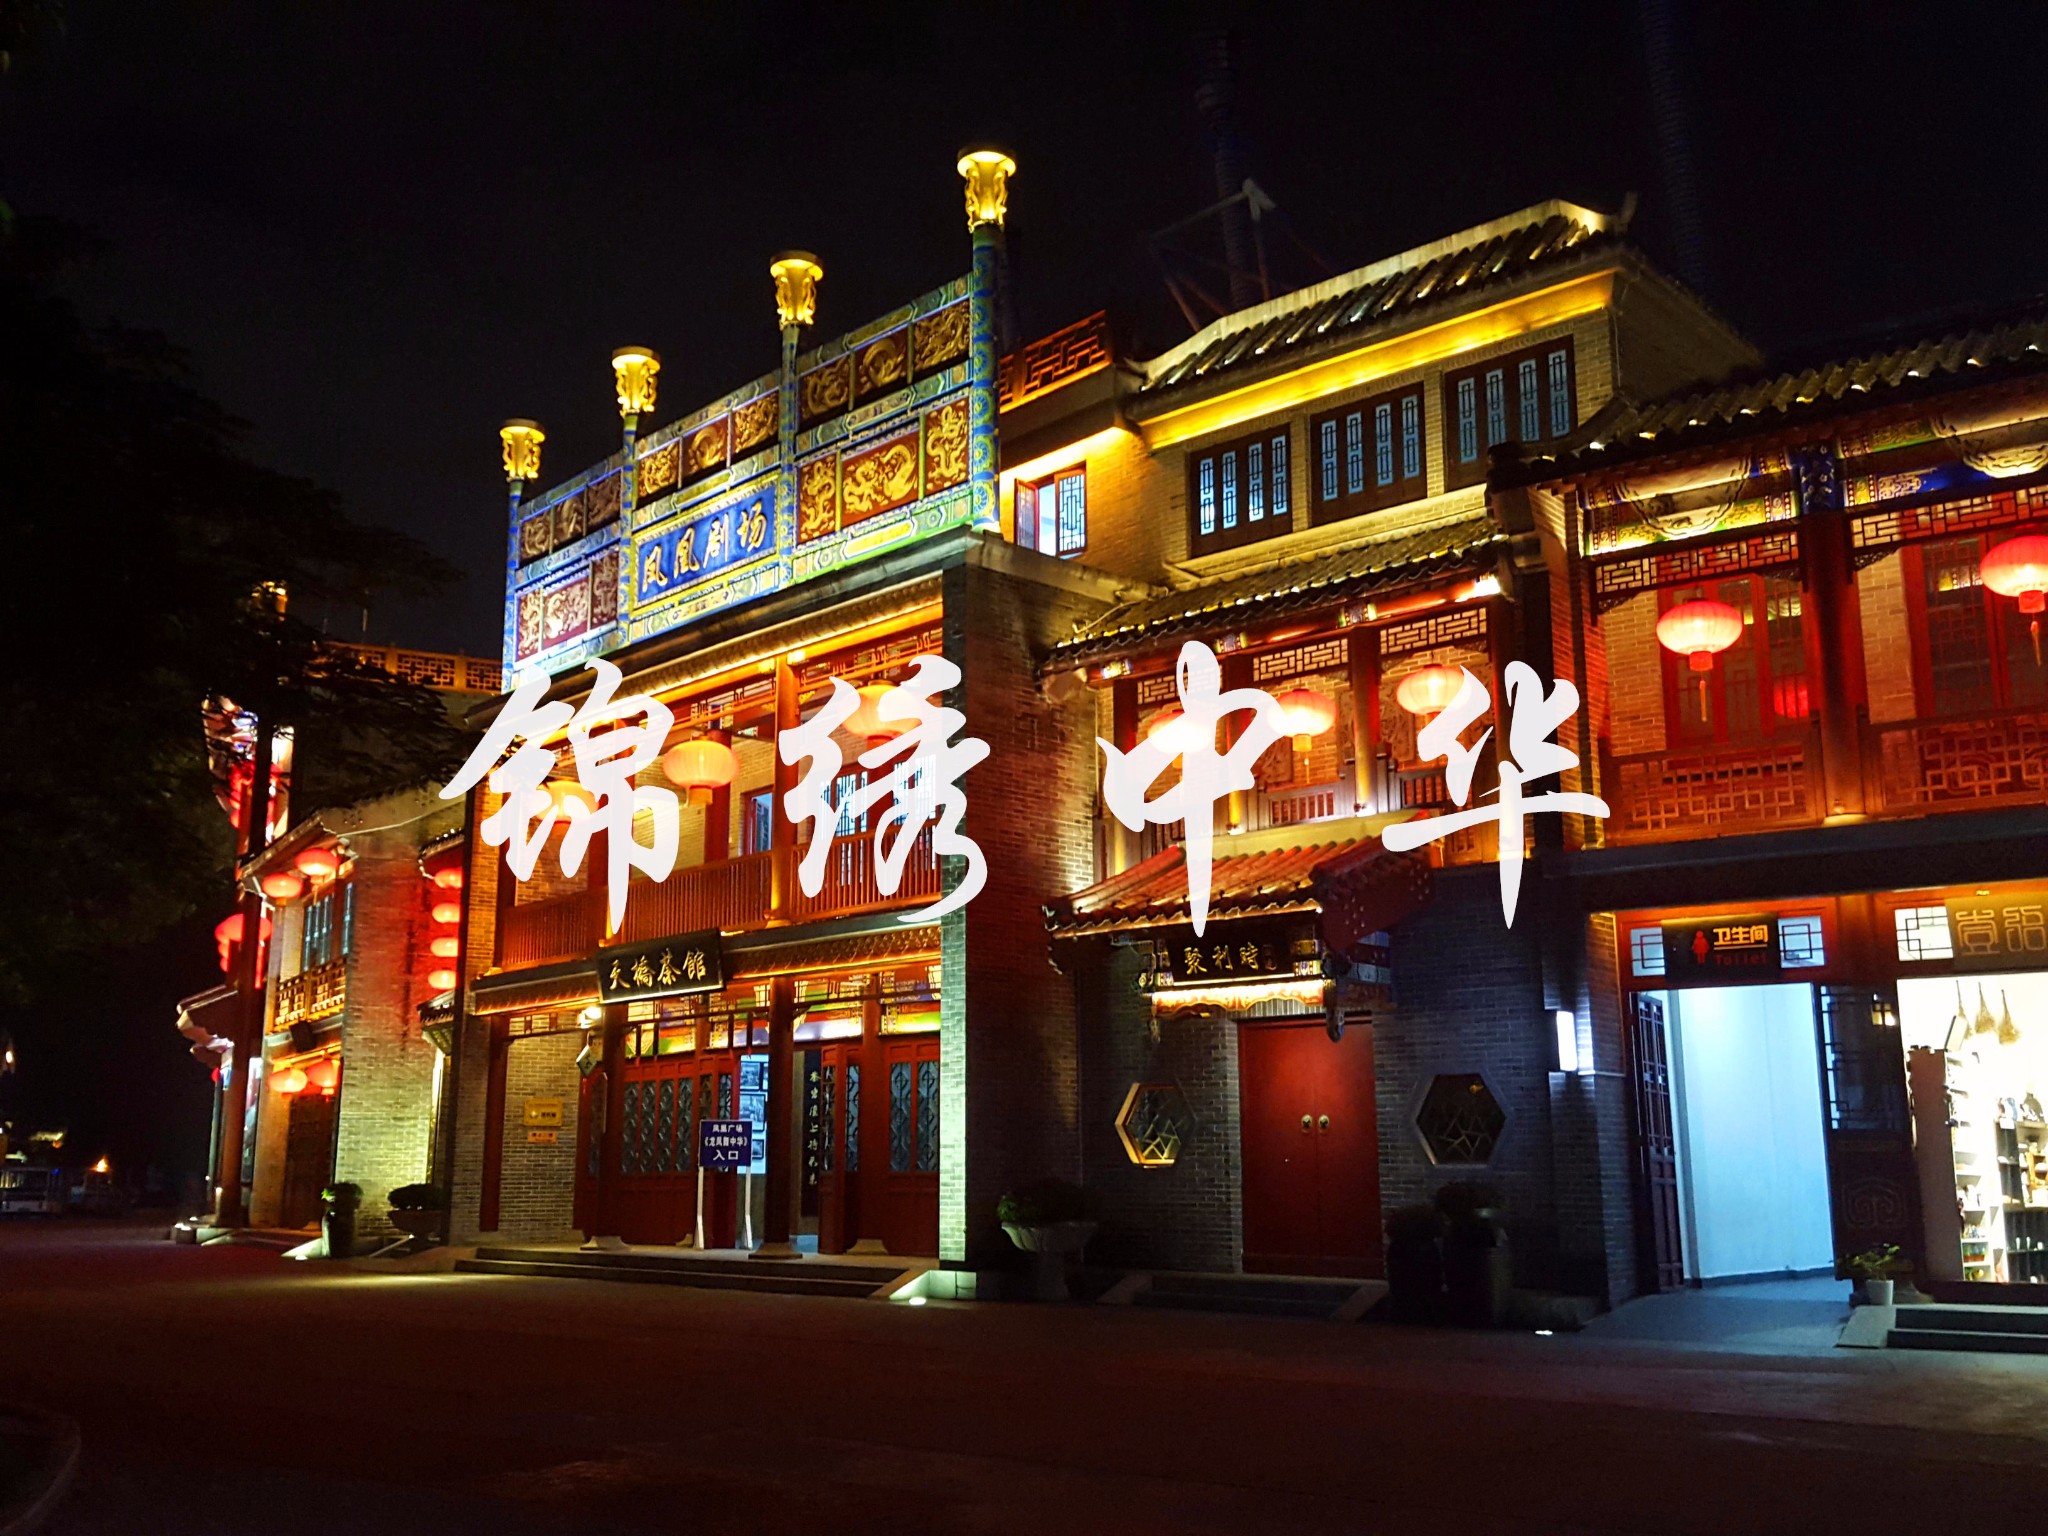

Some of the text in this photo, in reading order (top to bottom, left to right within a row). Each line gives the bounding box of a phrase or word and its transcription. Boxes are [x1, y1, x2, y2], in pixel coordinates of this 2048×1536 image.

[642, 500, 767, 593] 凤凰剧场
[1713, 925, 1768, 945] 卫生间
[712, 1149, 739, 1161] 入口
